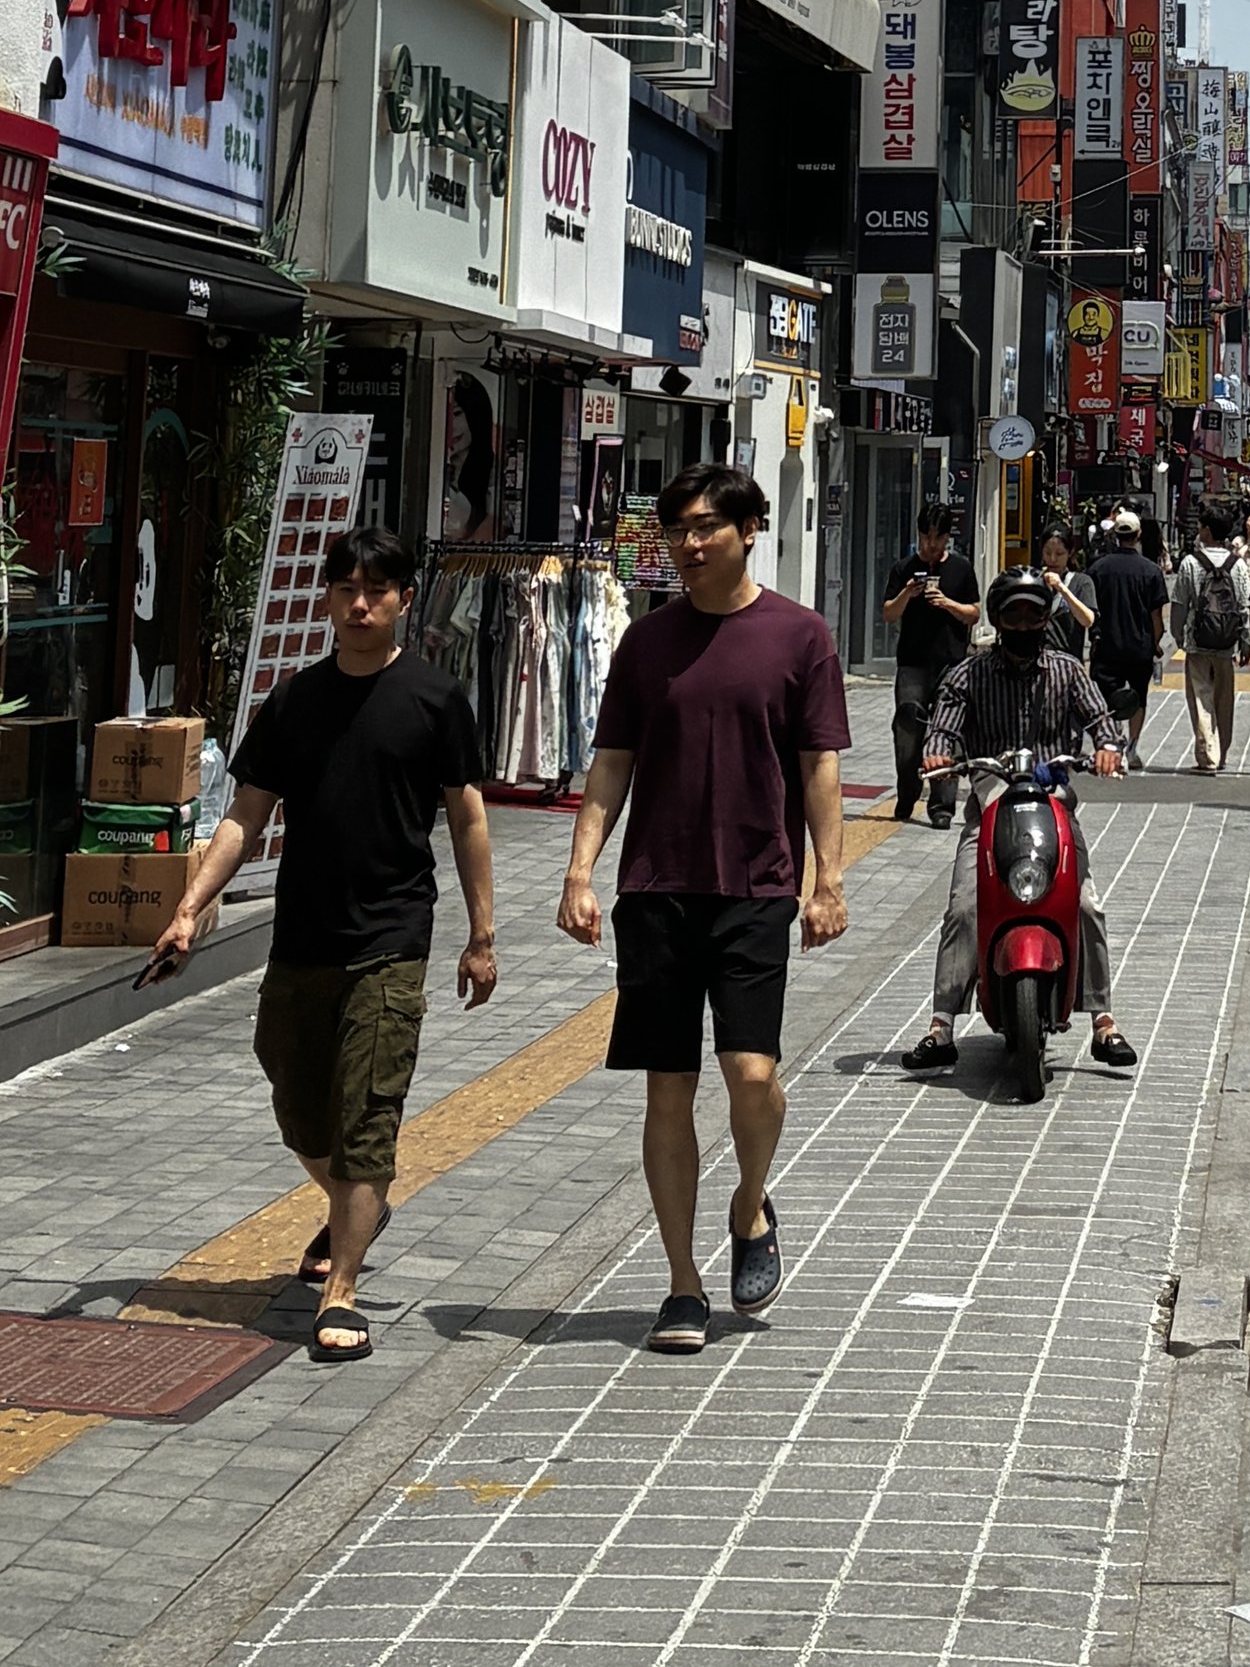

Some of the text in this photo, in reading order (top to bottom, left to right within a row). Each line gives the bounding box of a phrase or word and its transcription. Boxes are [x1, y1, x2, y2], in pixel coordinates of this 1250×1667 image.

[542, 118, 597, 217] COZY
[866, 210, 929, 229] OLENS
[1124, 329, 1151, 344] CU
[882, 349, 905, 363] 24
[585, 396, 615, 424] 삼겹살
[97, 829, 155, 848] coupang
[88, 887, 162, 907] coupang
